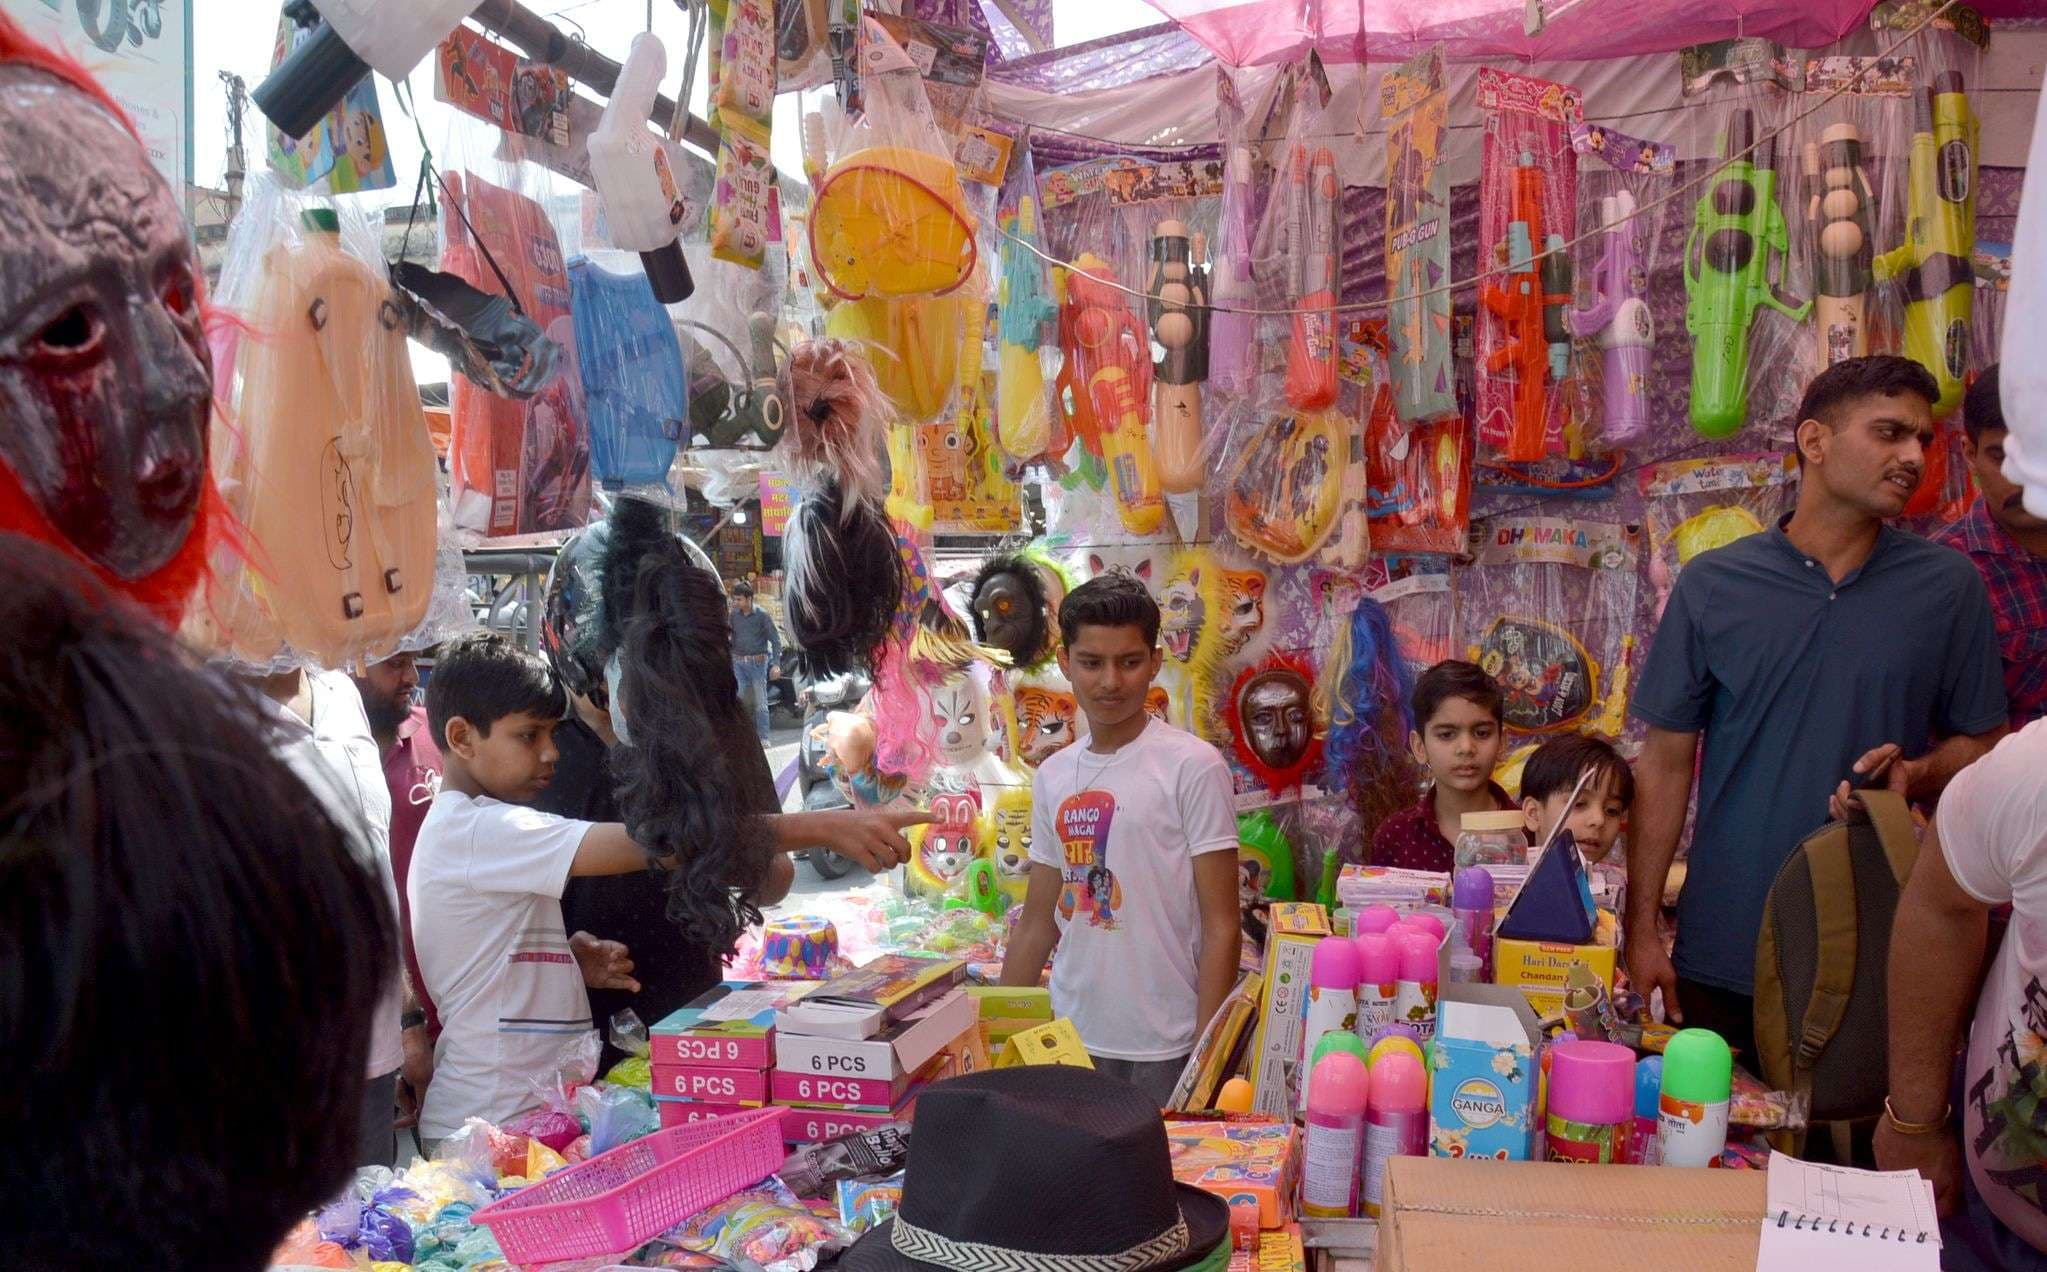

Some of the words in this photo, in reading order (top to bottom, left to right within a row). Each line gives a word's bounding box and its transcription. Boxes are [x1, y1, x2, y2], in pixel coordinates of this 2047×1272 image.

[1416, 219, 1440, 244] GUN
[1497, 526, 1588, 549] DHAMAKA
[1063, 807, 1100, 824] RANGO
[1523, 954, 1545, 967] Hari
[677, 1039, 721, 1060] PCS
[727, 1041, 739, 1060] 6
[811, 1055, 822, 1070] 6
[827, 1056, 866, 1072] PCS
[675, 1075, 687, 1093] 6
[692, 1075, 735, 1095] PCS
[798, 1080, 811, 1098] 6
[817, 1080, 861, 1101] PCS
[1453, 1099, 1504, 1114] GANGA
[806, 1121, 818, 1138] 6
